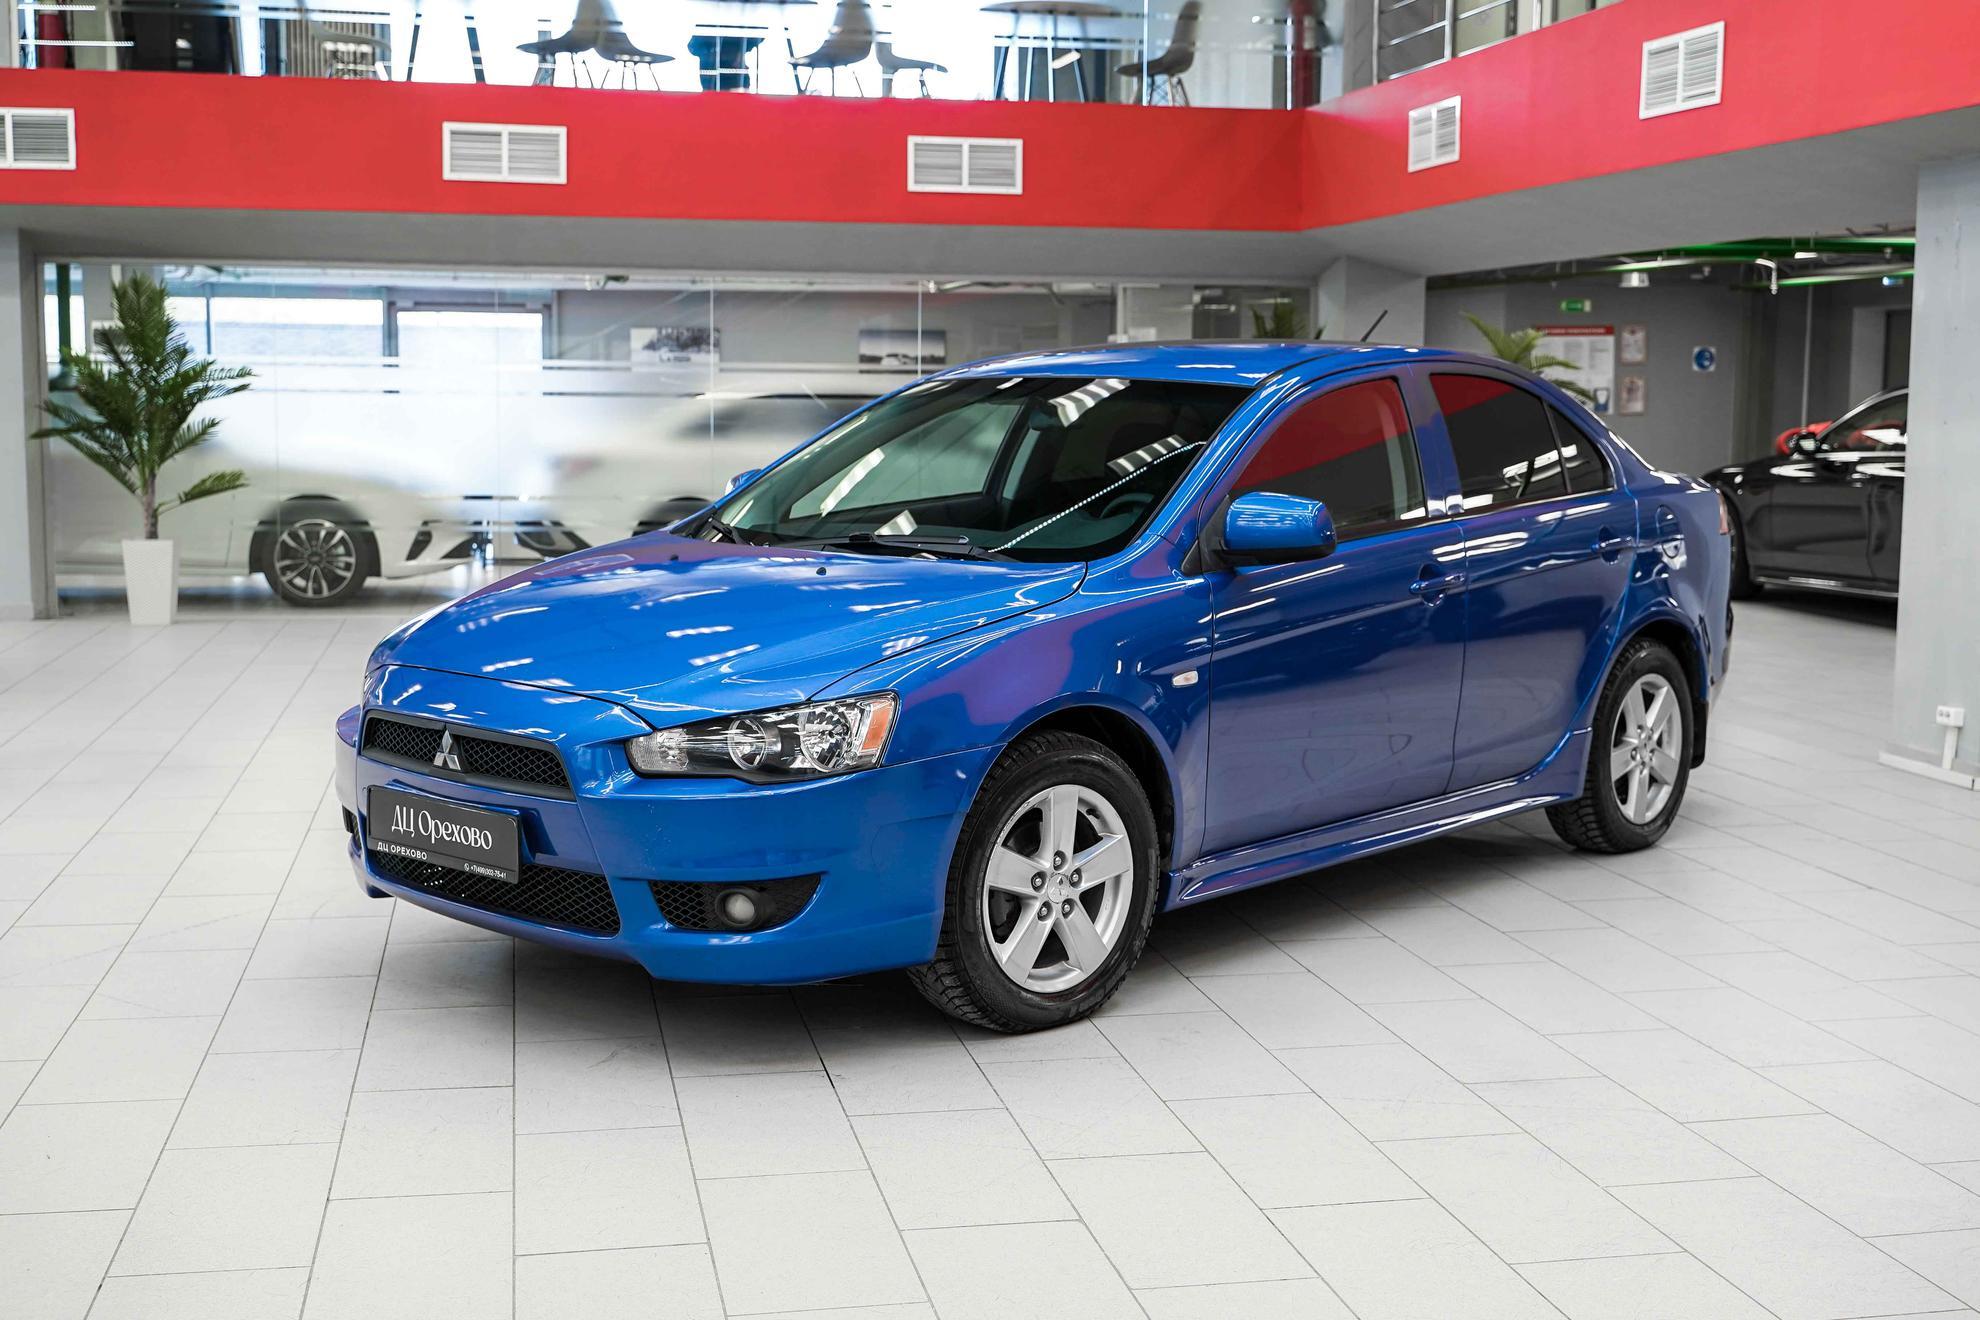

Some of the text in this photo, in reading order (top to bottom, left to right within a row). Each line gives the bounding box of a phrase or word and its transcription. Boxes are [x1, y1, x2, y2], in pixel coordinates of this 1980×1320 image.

[391, 805, 493, 850] ДЦ Орехово
[377, 842, 428, 860] ДЦ ОРЕХОВО
